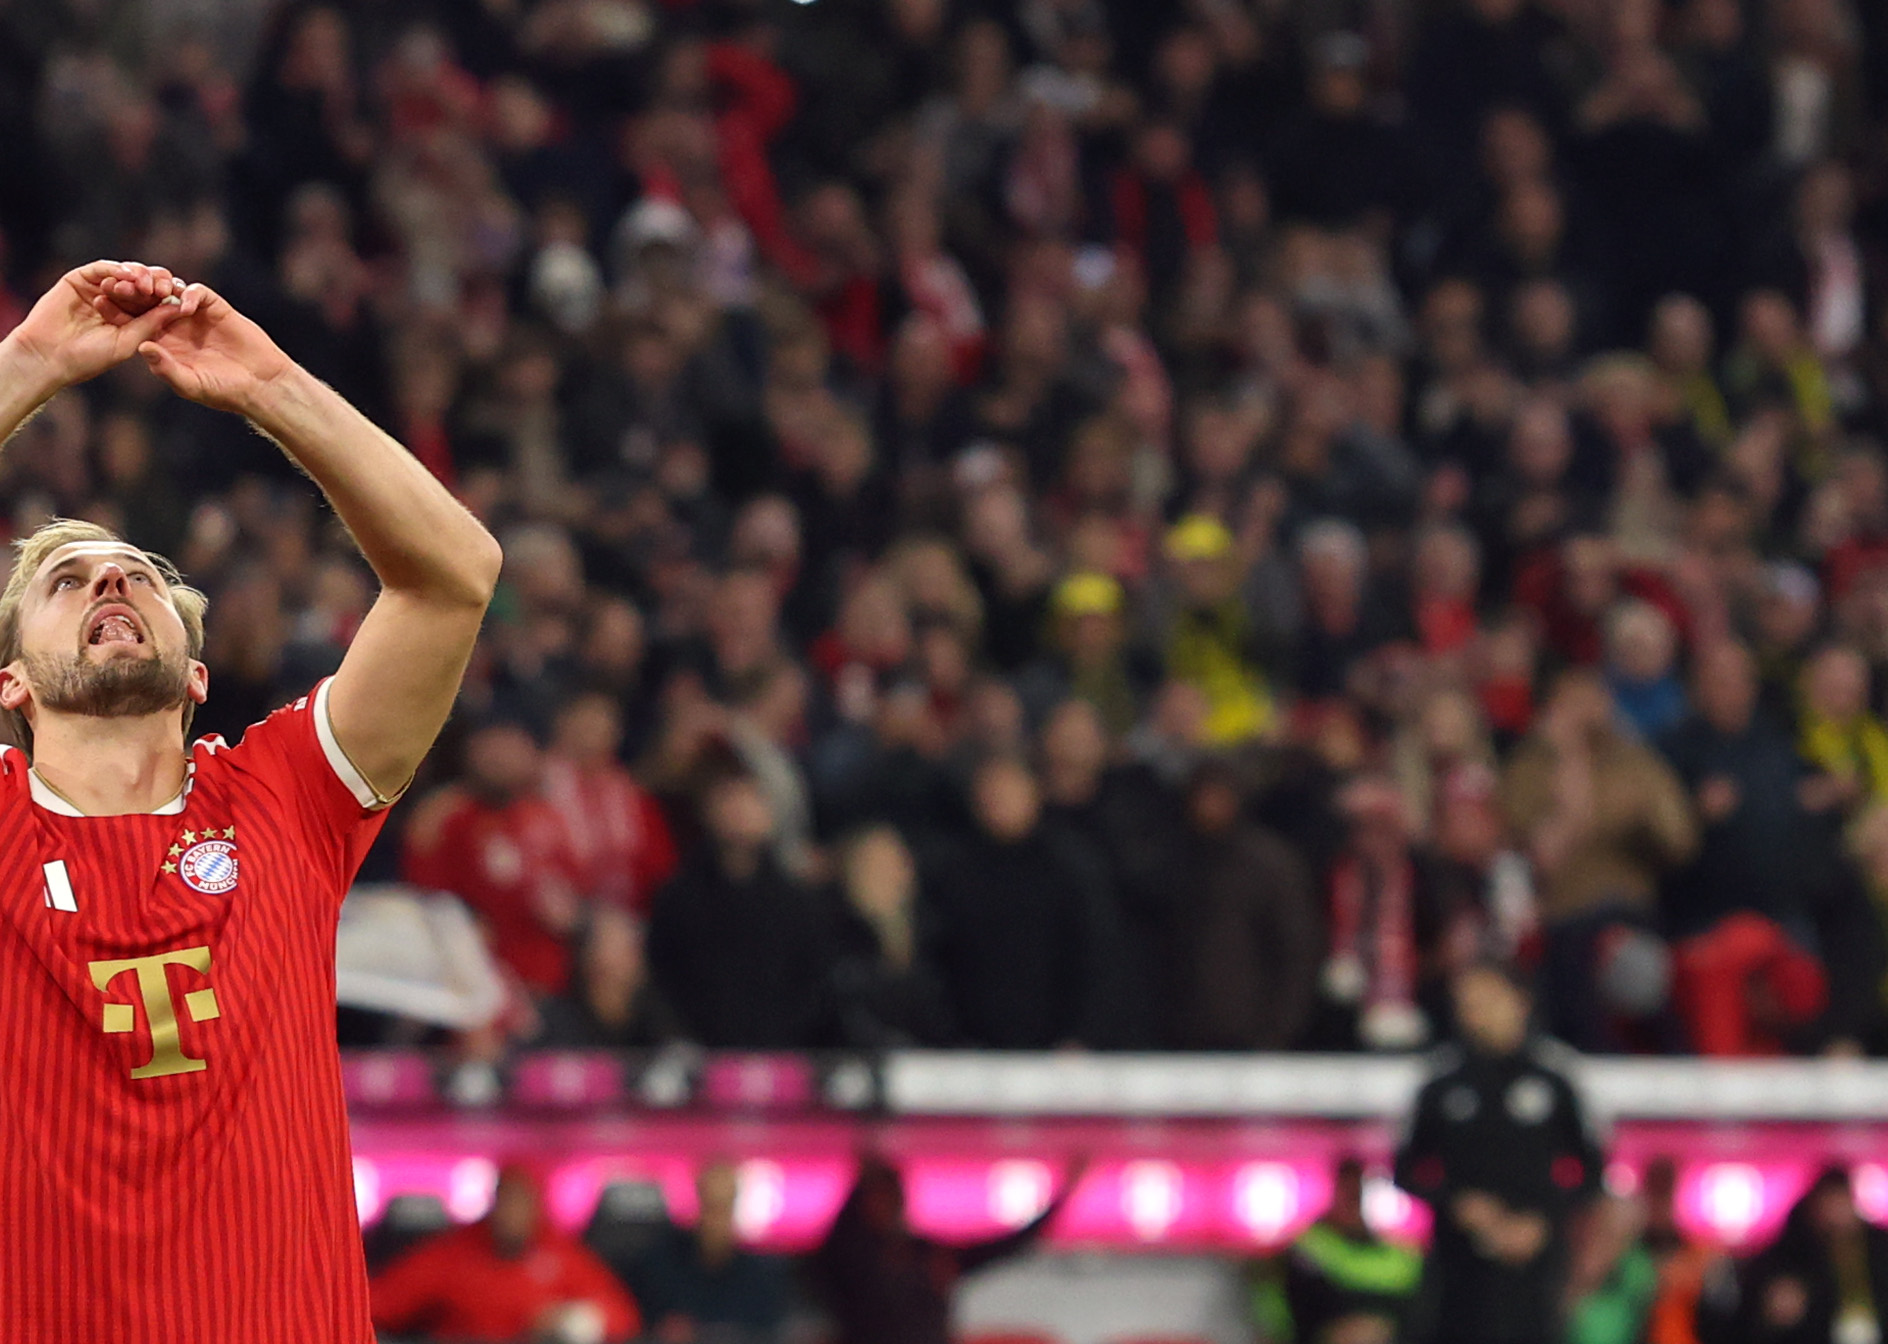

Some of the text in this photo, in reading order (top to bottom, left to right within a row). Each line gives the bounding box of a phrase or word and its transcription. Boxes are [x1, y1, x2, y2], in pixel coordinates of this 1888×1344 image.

[184, 844, 230, 877] FC BAYERN
[88, 946, 215, 1080] T
